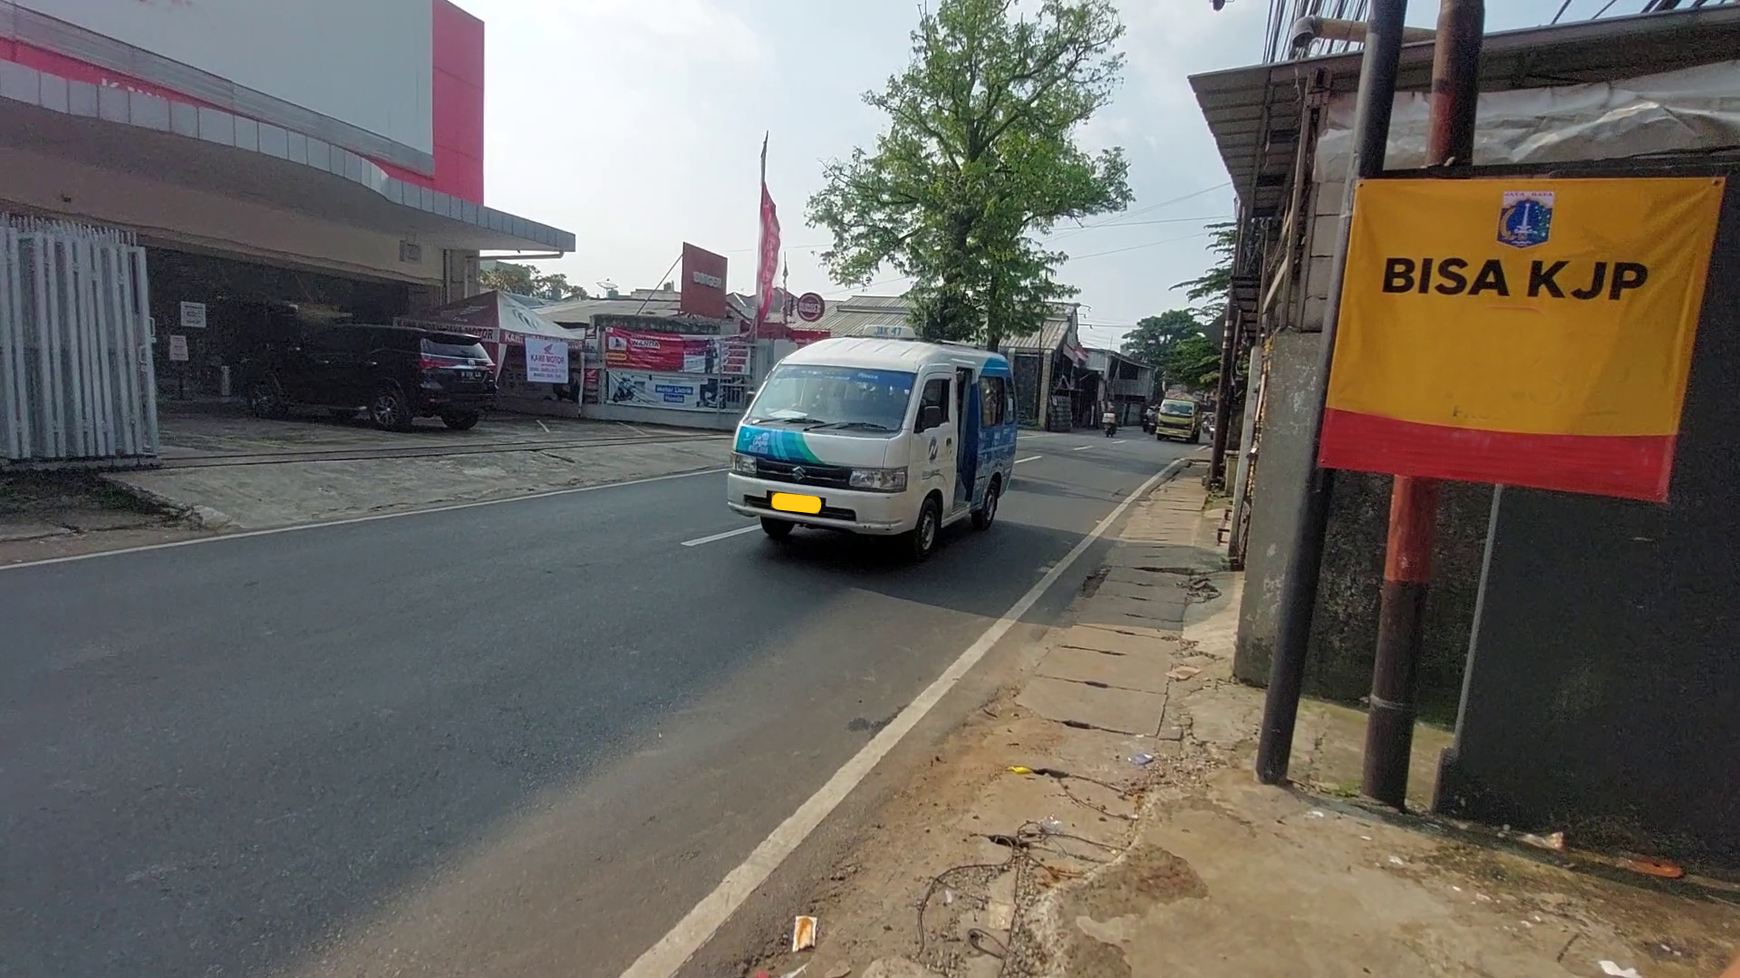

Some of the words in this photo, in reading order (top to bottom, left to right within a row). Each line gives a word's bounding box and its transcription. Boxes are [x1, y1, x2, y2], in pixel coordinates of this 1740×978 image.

[1382, 257, 1510, 296] BISA
[1526, 260, 1649, 301] KJP
[891, 327, 902, 336] 47
